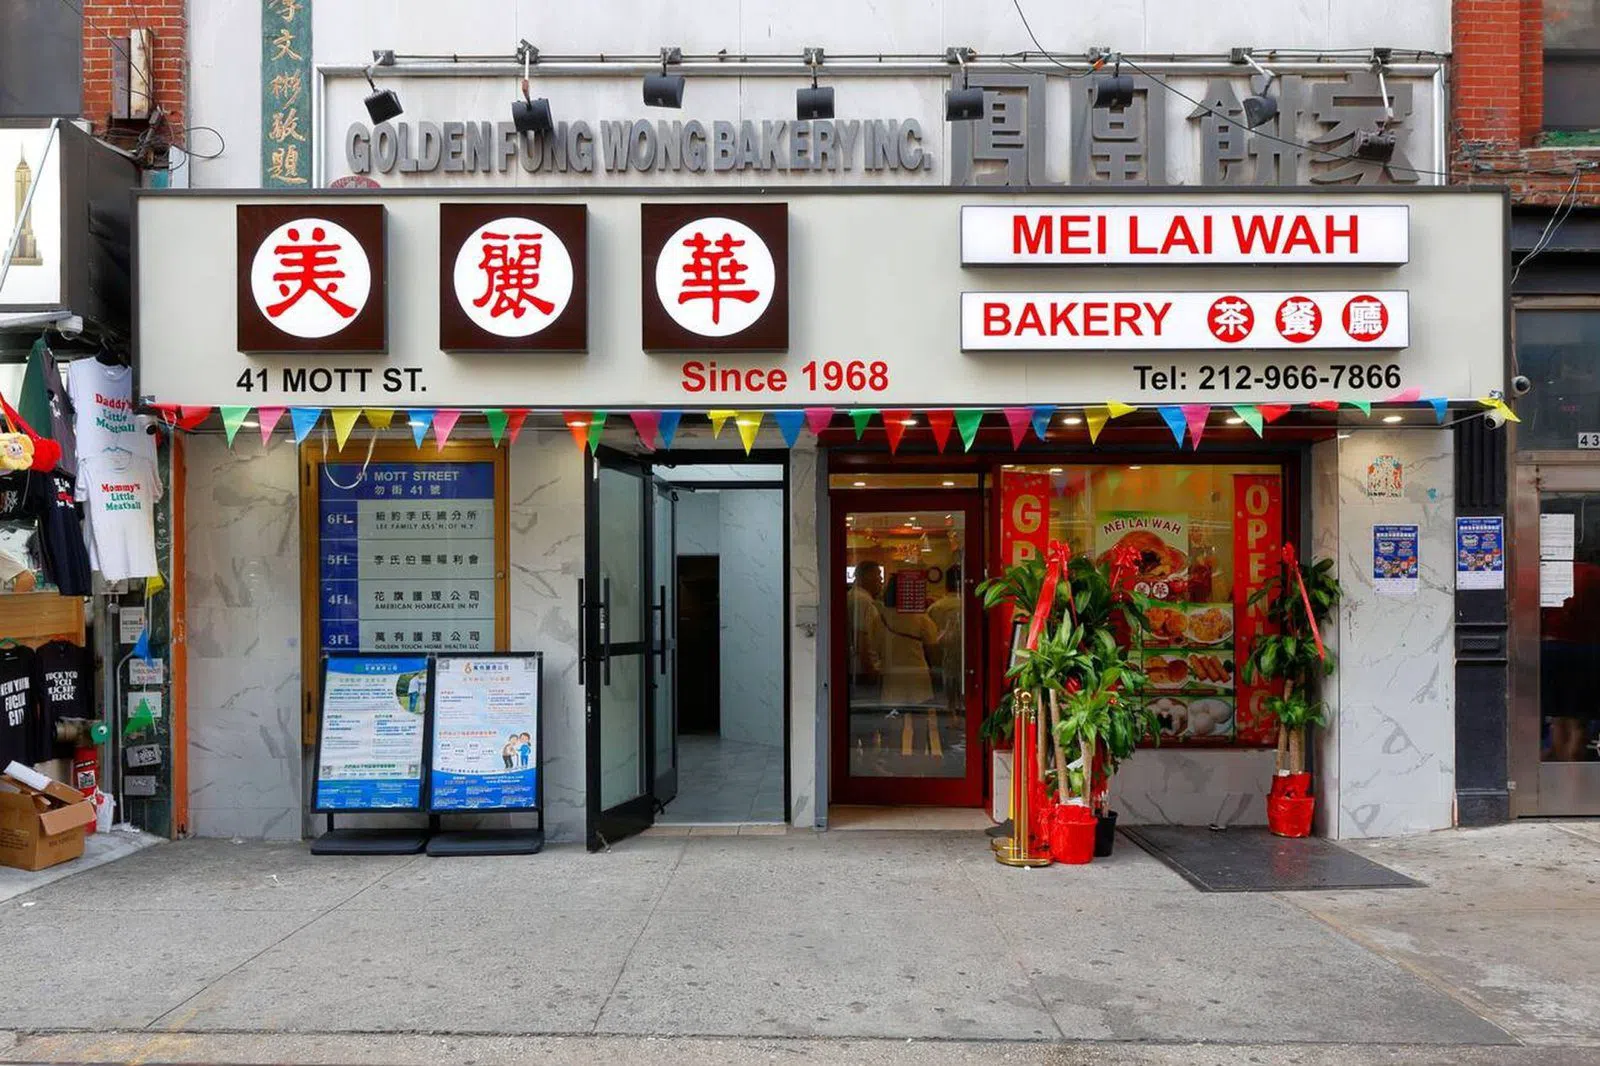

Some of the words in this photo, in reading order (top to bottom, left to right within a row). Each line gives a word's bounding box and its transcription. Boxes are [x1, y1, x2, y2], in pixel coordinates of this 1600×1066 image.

[346, 121, 492, 173] GOLDEN
[497, 120, 593, 173] FUNG
[600, 119, 707, 173] WONG
[713, 119, 861, 173] BAKERY
[863, 117, 932, 172] INC.
[1012, 215, 1107, 254] MEI
[1129, 215, 1212, 254] LAI
[1232, 215, 1359, 254] WAH
[983, 301, 1173, 337] BAKERY
[1212, 299, 1383, 336] 茶餐廳
[236, 368, 268, 392] 41
[283, 368, 372, 392] MOTT
[383, 368, 427, 392] ST.
[681, 361, 788, 392] Since
[802, 360, 889, 391] 1968
[1134, 366, 1187, 390] Tel:
[1199, 364, 1402, 390] 212-966-7866
[1580, 434, 1600, 446] 43
[374, 472, 408, 481] MOTT
[413, 472, 460, 481] STREET
[101, 483, 140, 493] Mommy's
[111, 492, 135, 501] Little
[105, 501, 141, 511] Meatball
[327, 514, 354, 524] 6FL
[1104, 520, 1125, 534] MEI
[1129, 519, 1148, 528] LAI
[1152, 518, 1181, 534] WAH
[327, 554, 351, 565] 5FL
[328, 595, 352, 604] 4FL
[328, 635, 353, 645] 3FL
